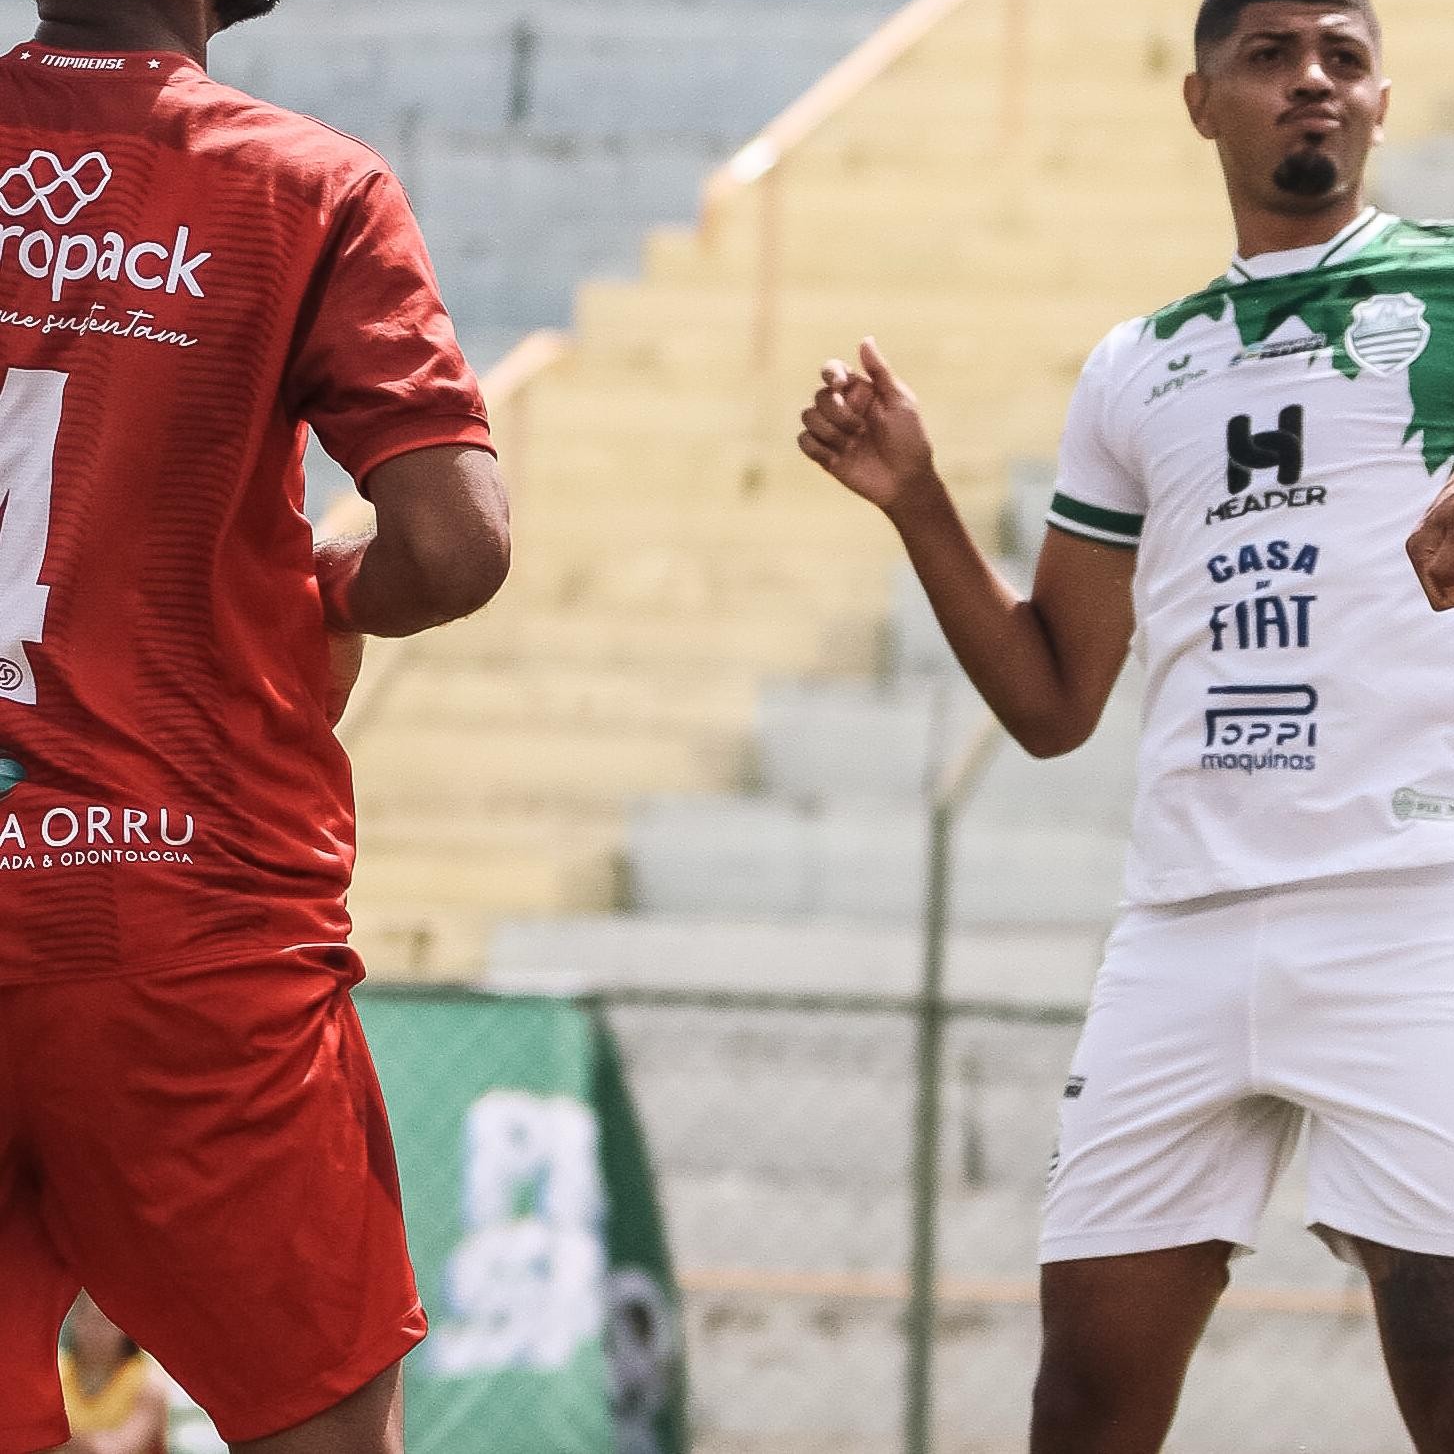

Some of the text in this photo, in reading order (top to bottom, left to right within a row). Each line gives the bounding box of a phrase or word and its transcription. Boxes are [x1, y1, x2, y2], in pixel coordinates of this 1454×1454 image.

[1205, 485, 1327, 526] HEADER
[1207, 541, 1319, 583] CASA
[1209, 595, 1318, 651] FIAT
[41, 806, 195, 847] ORRU
[42, 852, 53, 868] &
[60, 848, 194, 867] ODONTOLOGIA
